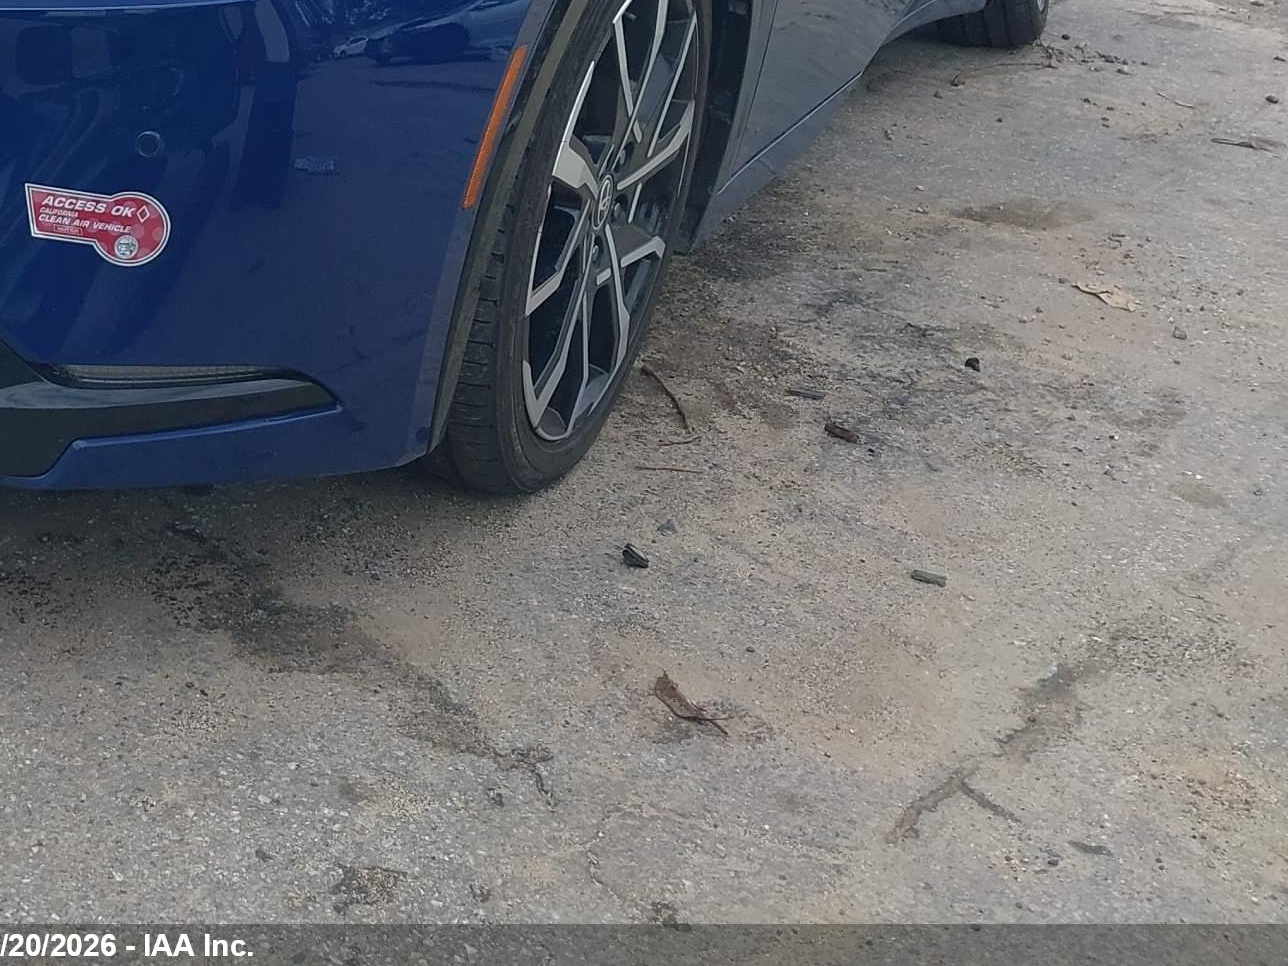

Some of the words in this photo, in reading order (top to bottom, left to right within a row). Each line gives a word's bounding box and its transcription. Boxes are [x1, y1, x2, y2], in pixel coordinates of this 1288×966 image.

[39, 206, 79, 218] CALIFORNIA
[41, 195, 106, 213] ACCESS
[111, 205, 136, 218] OK
[38, 213, 70, 225] CLEAN
[73, 218, 89, 228] AIR
[93, 221, 132, 233] VEHICLE
